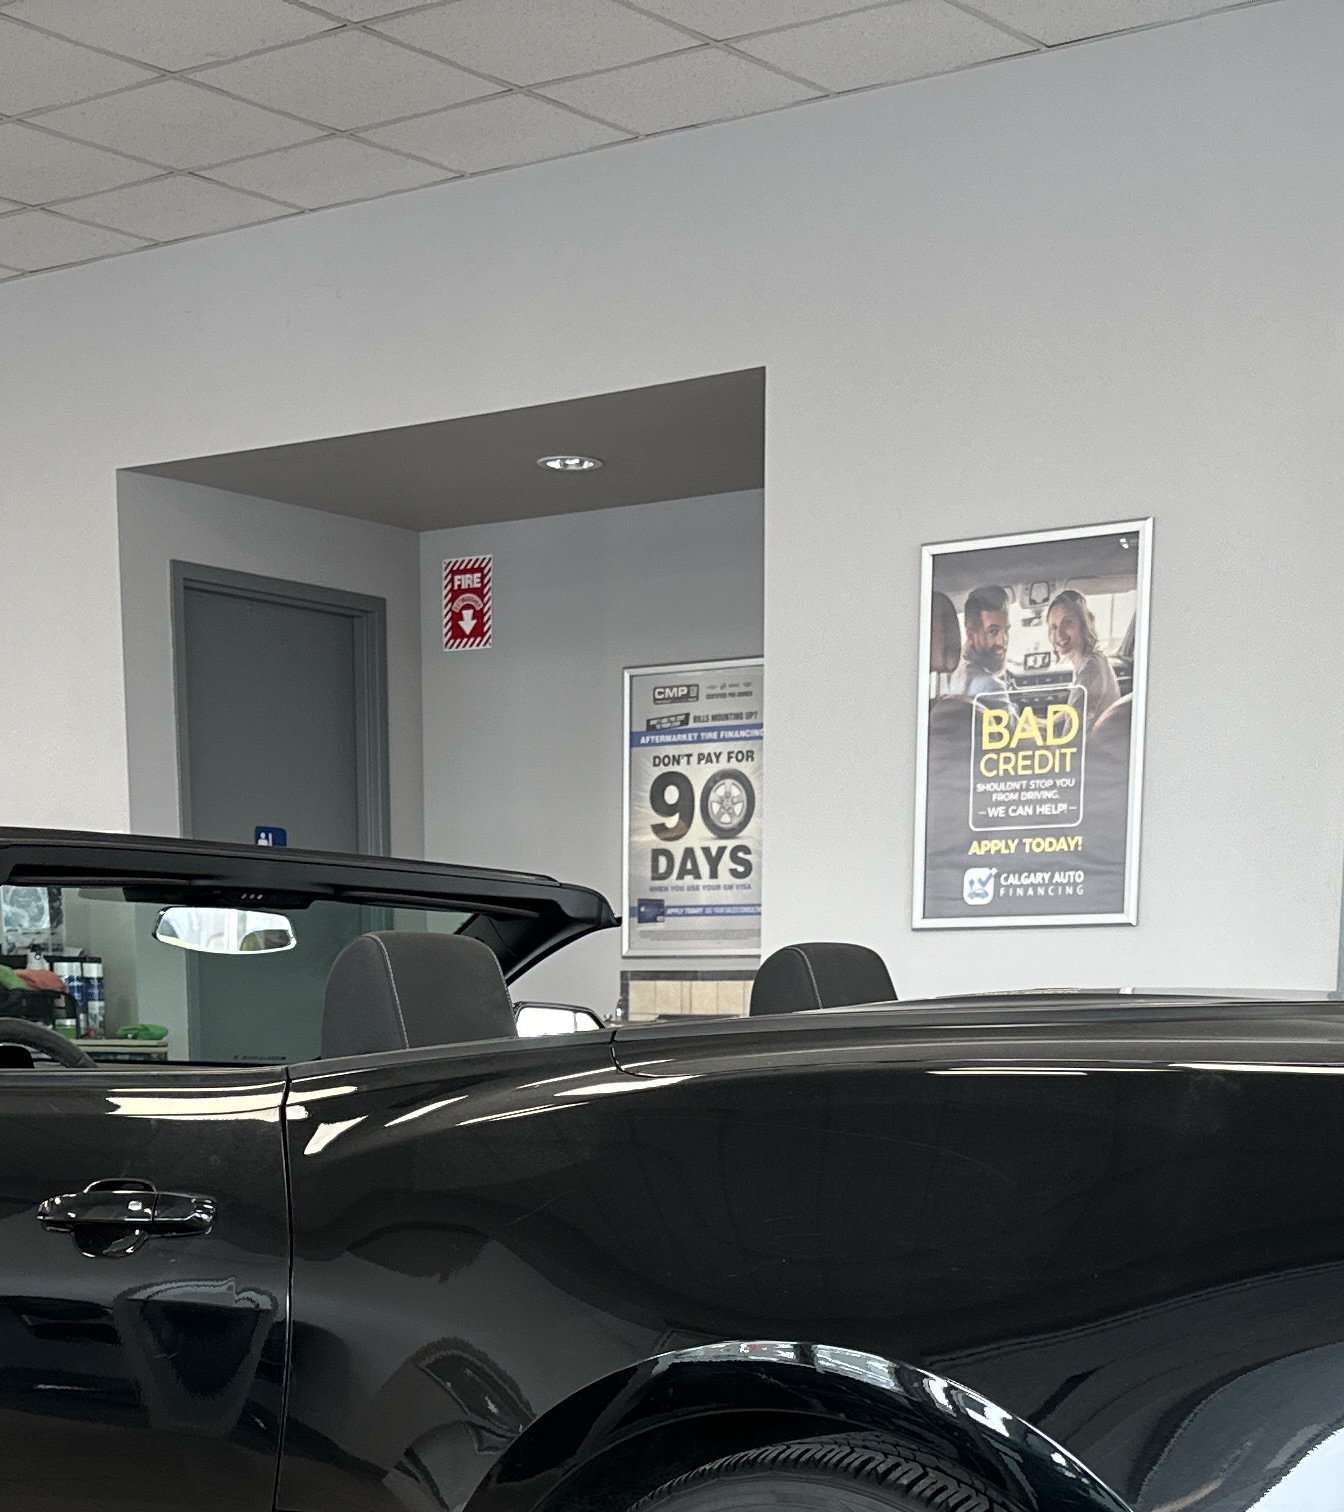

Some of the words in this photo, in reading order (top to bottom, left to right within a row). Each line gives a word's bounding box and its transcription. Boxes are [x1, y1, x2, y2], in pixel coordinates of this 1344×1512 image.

[453, 573, 482, 590] FIRE
[654, 687, 688, 699] CMP
[982, 704, 1079, 750] BAD
[640, 733, 698, 744] AFTERMARKET
[701, 731, 718, 741] TIRE
[652, 753, 692, 767] DON'T
[697, 752, 722, 765] PAY
[727, 750, 754, 763] FOR
[979, 748, 1077, 777] CREDIT
[976, 781, 1027, 792] SHOULDN'T
[1029, 779, 1053, 789] STOP
[1055, 778, 1076, 788] YOU
[649, 768, 756, 842] 90
[992, 792, 1019, 802] FROM
[987, 806, 1006, 817] WE
[1008, 804, 1033, 816] CAN
[1036, 803, 1068, 815] HELP!
[968, 838, 1019, 855] APPLY
[1023, 836, 1083, 853] TODAY!
[651, 844, 753, 881] DAYS
[1000, 871, 1051, 886] CALGARY
[1052, 870, 1084, 884] AUTO
[999, 885, 1084, 897] FINANCING
